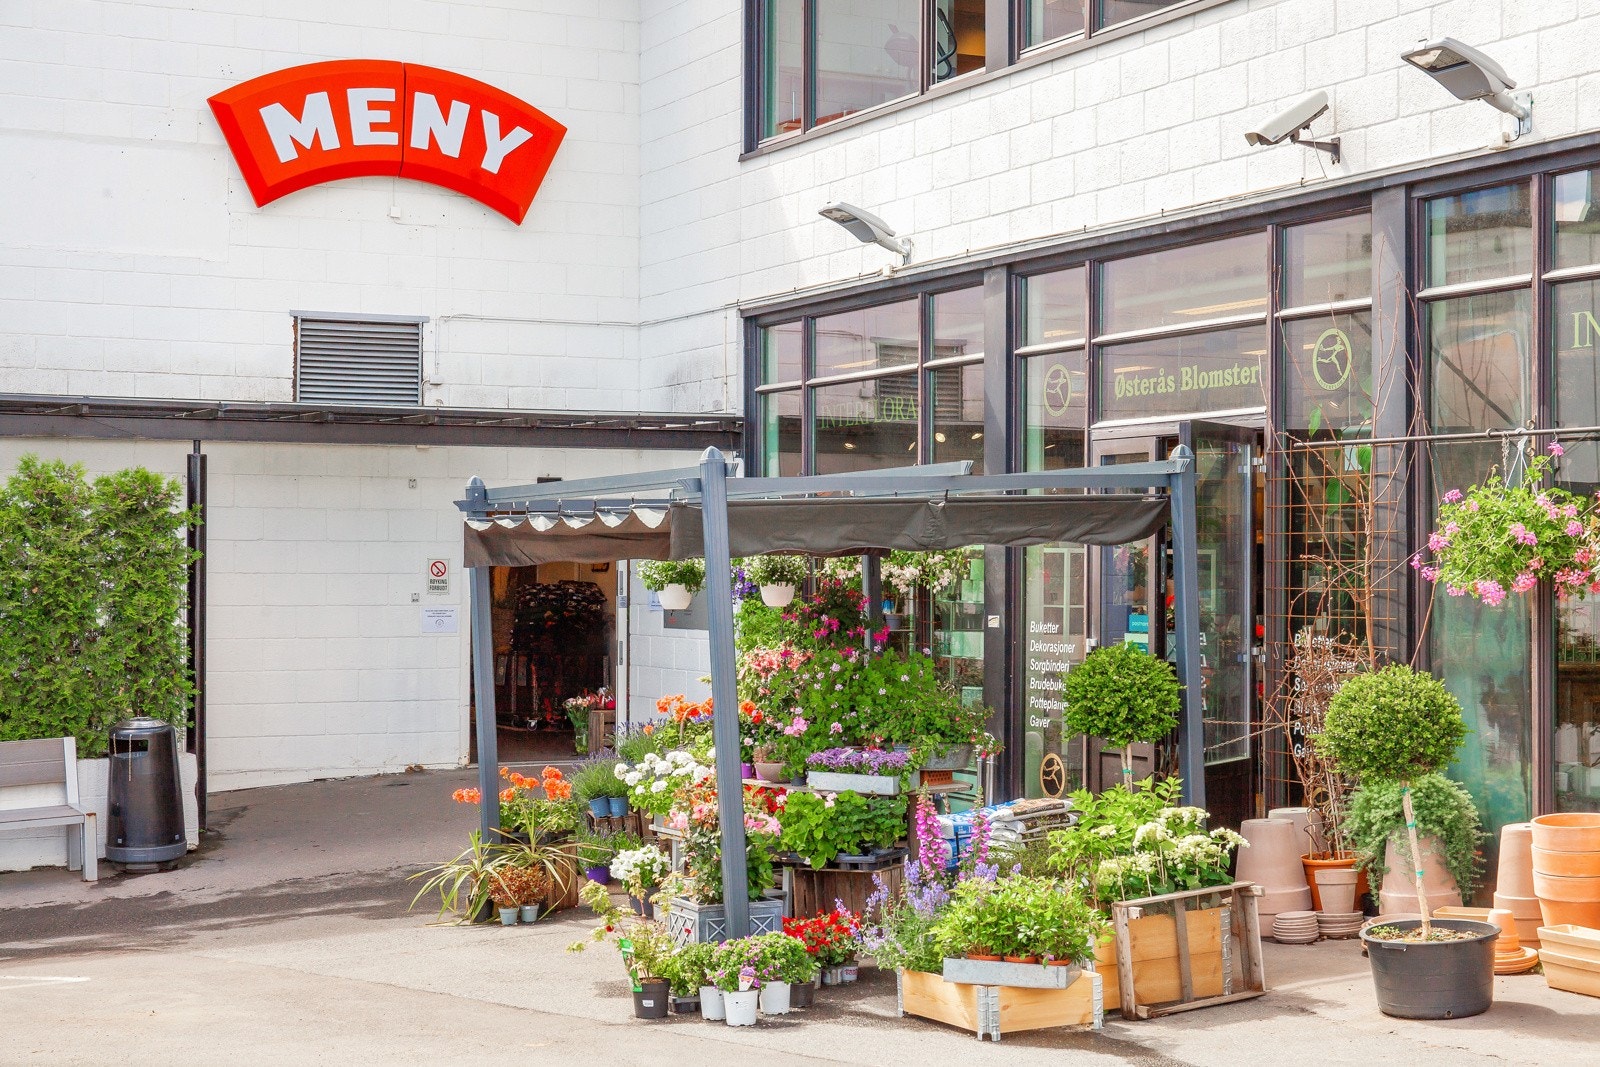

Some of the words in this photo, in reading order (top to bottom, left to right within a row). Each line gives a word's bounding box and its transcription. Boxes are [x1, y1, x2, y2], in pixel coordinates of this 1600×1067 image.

[259, 88, 533, 174] MENY
[1114, 368, 1176, 400] Østerås
[1180, 362, 1260, 391] Blomster
[821, 395, 918, 429] INTERFLORA
[1029, 621, 1060, 634] Buketter
[1029, 640, 1076, 655] Dekorasjoner
[1029, 658, 1070, 674] Sorgbinderi
[1029, 677, 1067, 692] Brudebuke
[1029, 714, 1051, 728] Gaver
